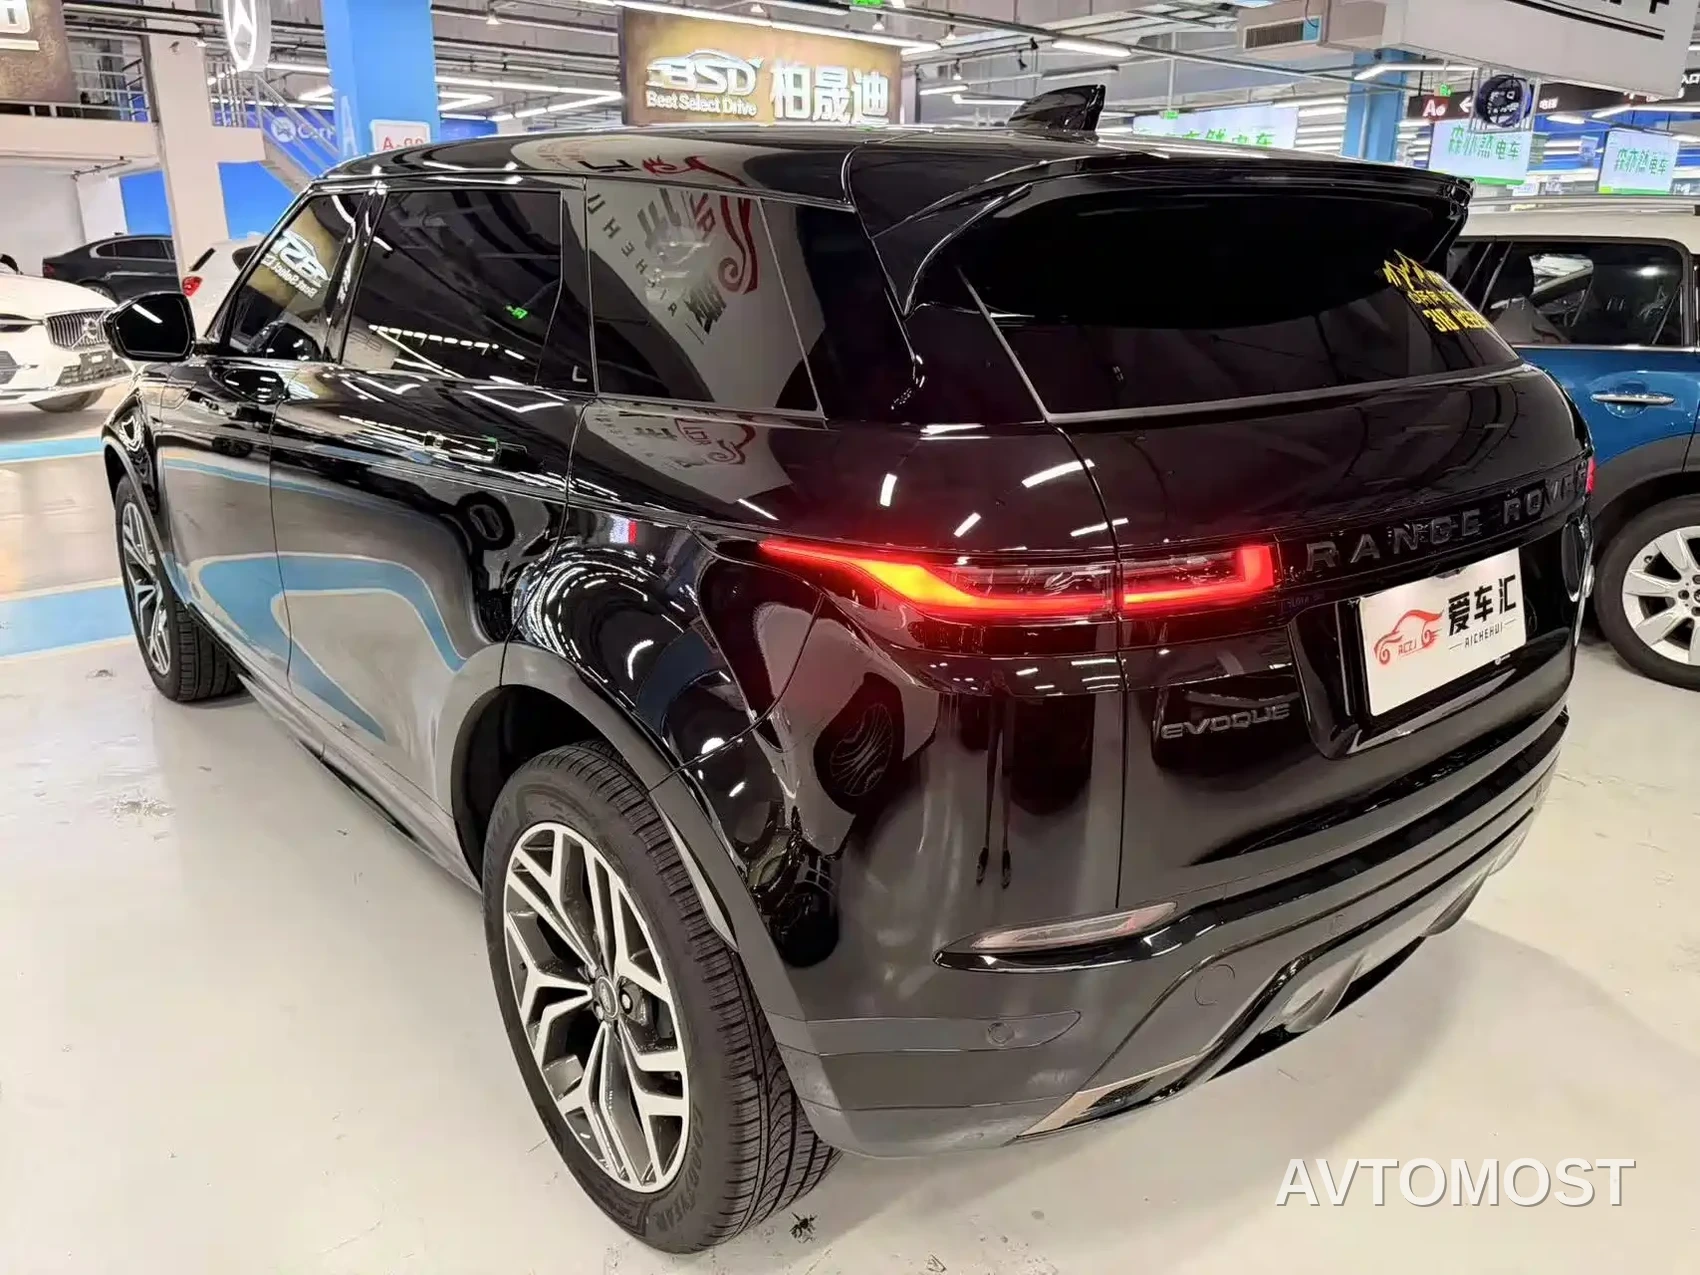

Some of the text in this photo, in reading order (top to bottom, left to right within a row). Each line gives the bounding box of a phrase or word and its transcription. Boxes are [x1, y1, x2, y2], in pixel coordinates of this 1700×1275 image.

[645, 49, 763, 96] BSD
[770, 59, 889, 125] 柏晟迪
[645, 90, 757, 117] Best Select Drive
[1306, 509, 1481, 572] RANGE
[1447, 574, 1517, 636] 爱车汇
[1161, 703, 1290, 740] EVOQUE
